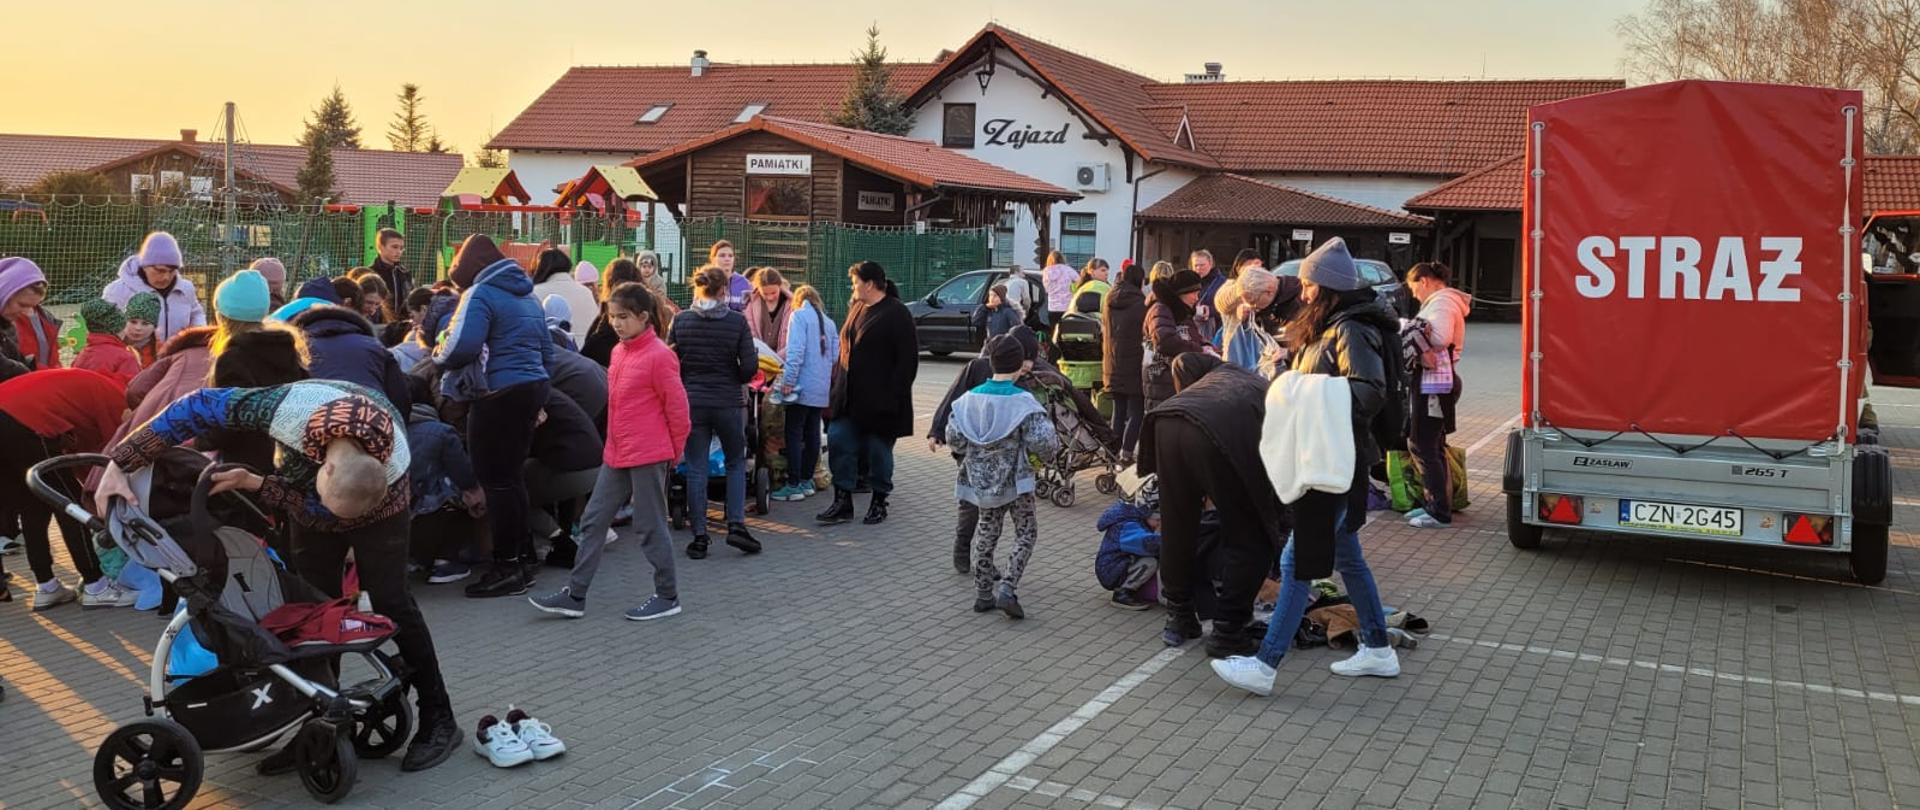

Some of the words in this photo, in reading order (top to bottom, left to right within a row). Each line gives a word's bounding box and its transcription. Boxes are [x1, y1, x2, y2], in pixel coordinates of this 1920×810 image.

[983, 118, 1070, 149] Zajazd
[750, 158, 803, 171] PAMIĄTKI
[1744, 467, 1775, 477] 265
[1635, 503, 1674, 524] CZN
[1683, 507, 1736, 529] 2G45
